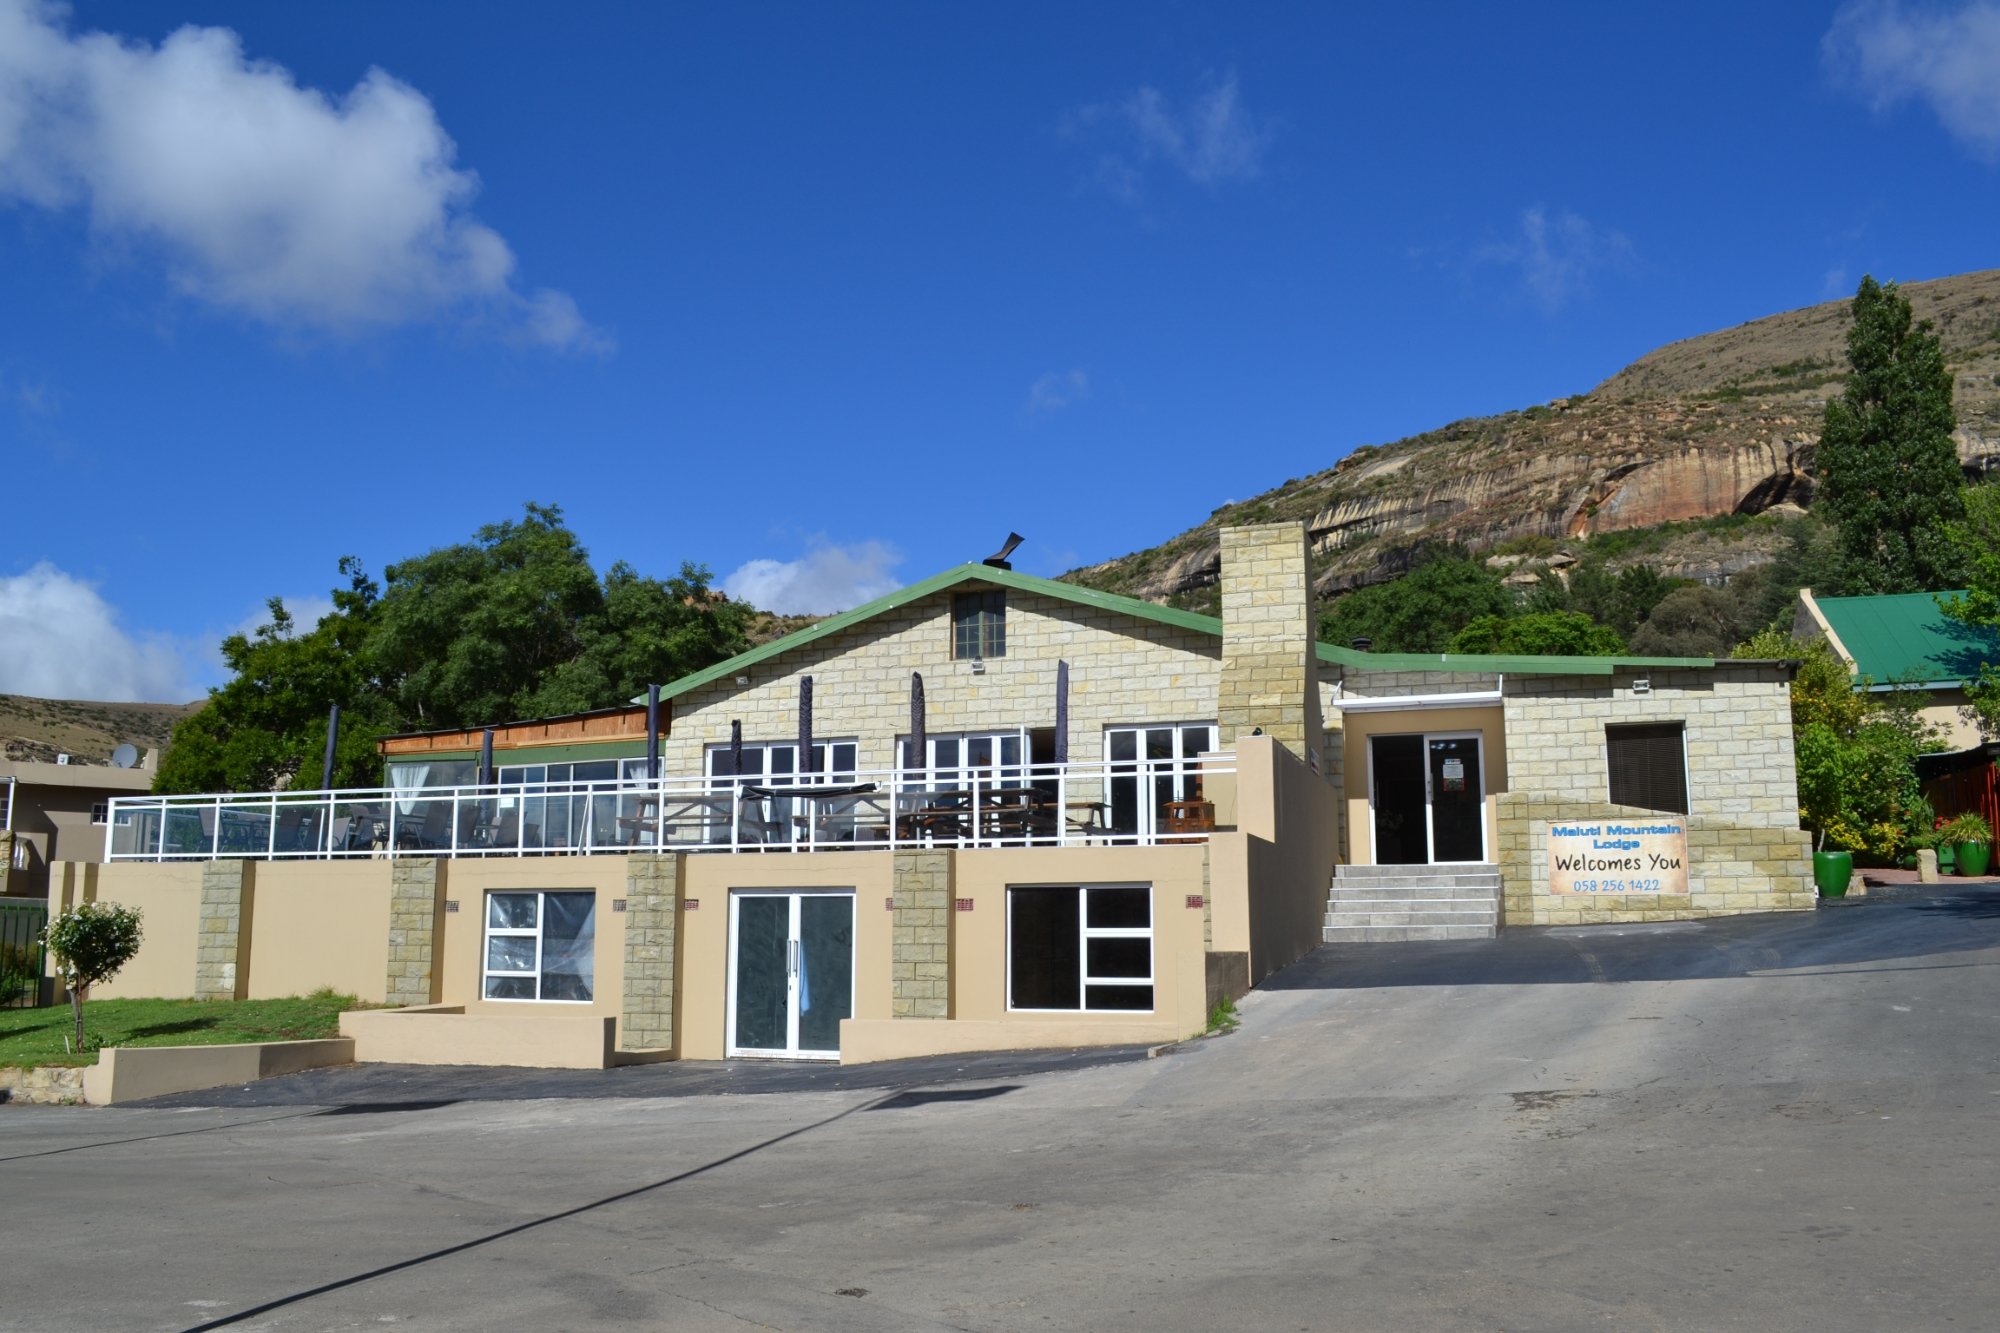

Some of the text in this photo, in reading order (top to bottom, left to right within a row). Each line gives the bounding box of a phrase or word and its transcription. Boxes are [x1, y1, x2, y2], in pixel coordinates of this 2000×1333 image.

[1606, 825, 1681, 835] Mountain
[1593, 839, 1640, 850] Lodge
[1555, 854, 1681, 871] Welcomes You
[1574, 880, 1660, 891] 058 256 1422
